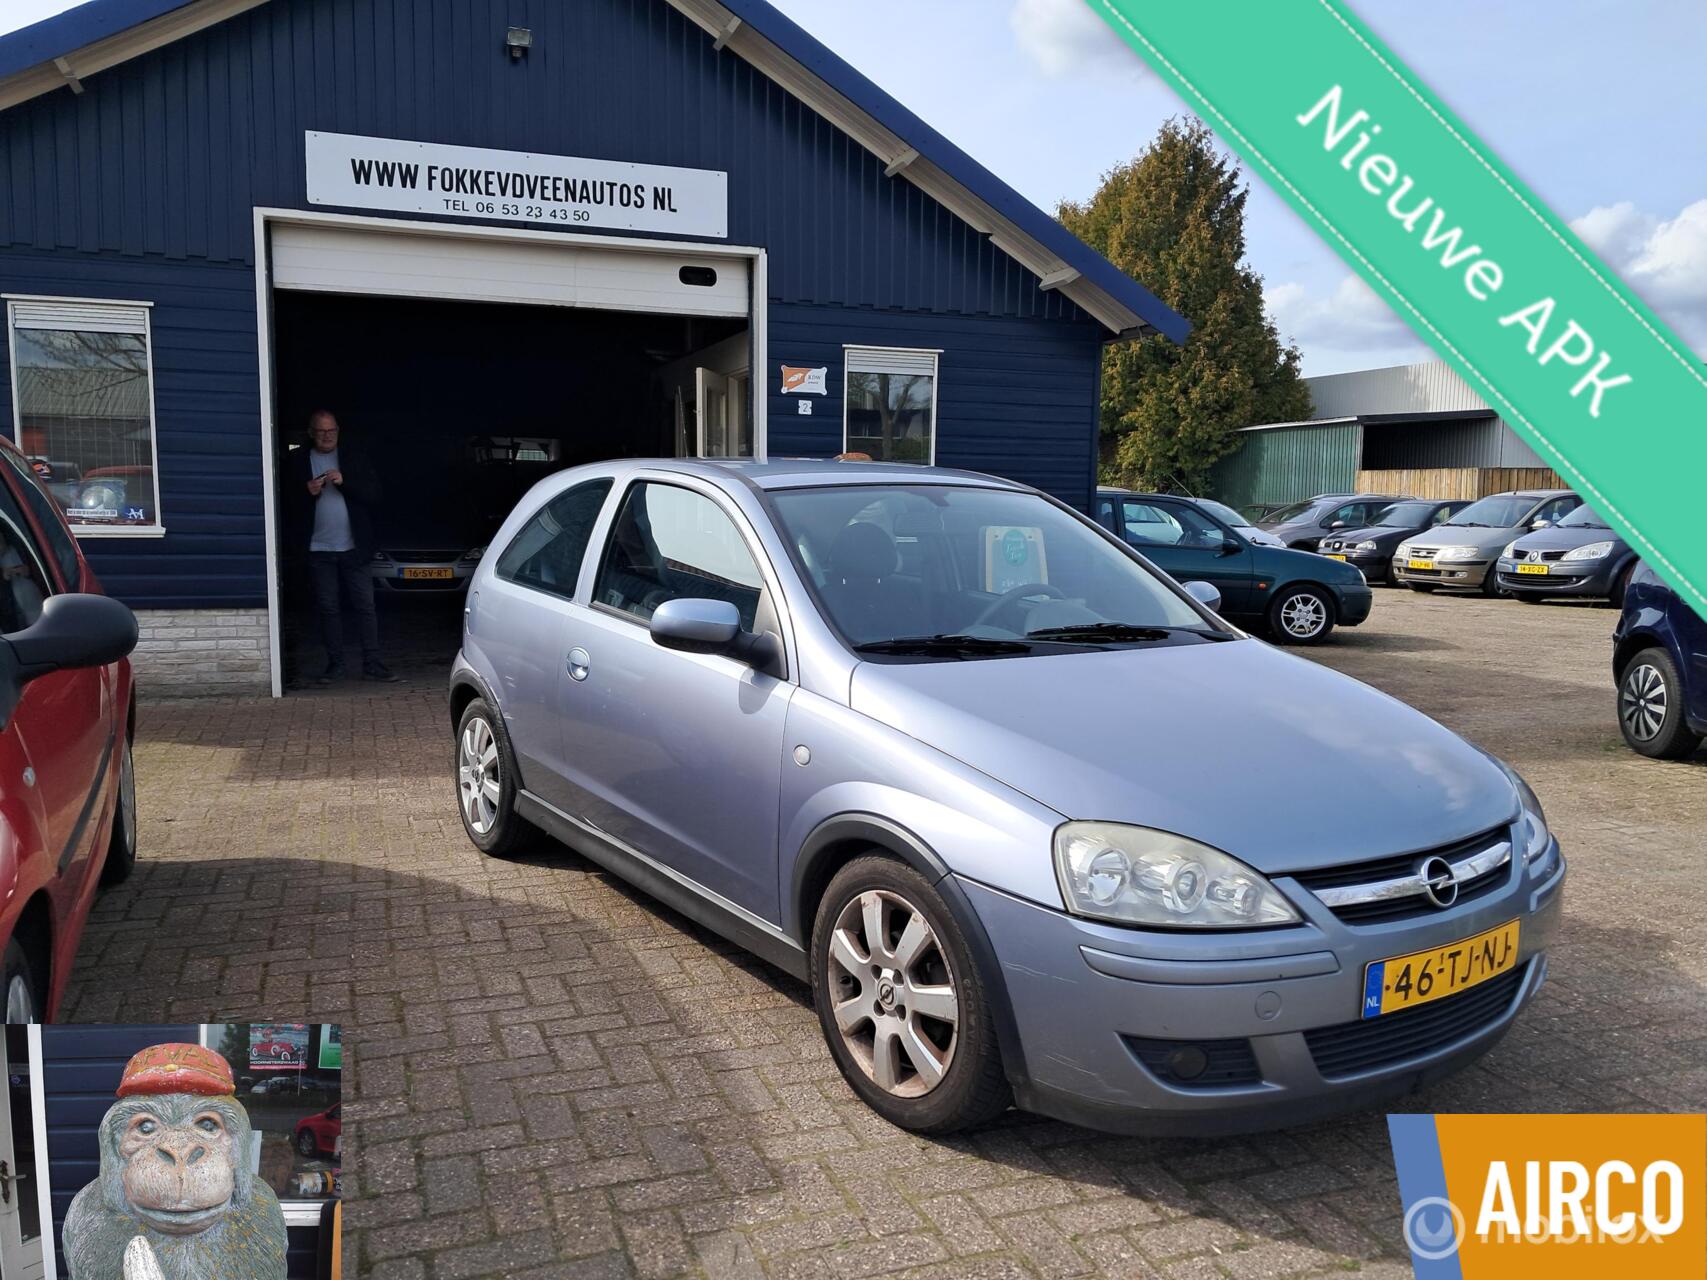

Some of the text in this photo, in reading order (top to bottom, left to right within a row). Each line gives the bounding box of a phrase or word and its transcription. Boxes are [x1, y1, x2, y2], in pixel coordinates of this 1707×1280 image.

[350, 158, 678, 213] WWW FOKKEVDVEENAUTOS NL
[443, 199, 590, 221] TEL 06 53 23 43 50
[802, 402, 809, 412] 2
[408, 569, 448, 578] 16-SV-RT
[1394, 932, 1510, 1000] 46-TJ-NJ
[1366, 995, 1380, 1009] NL
